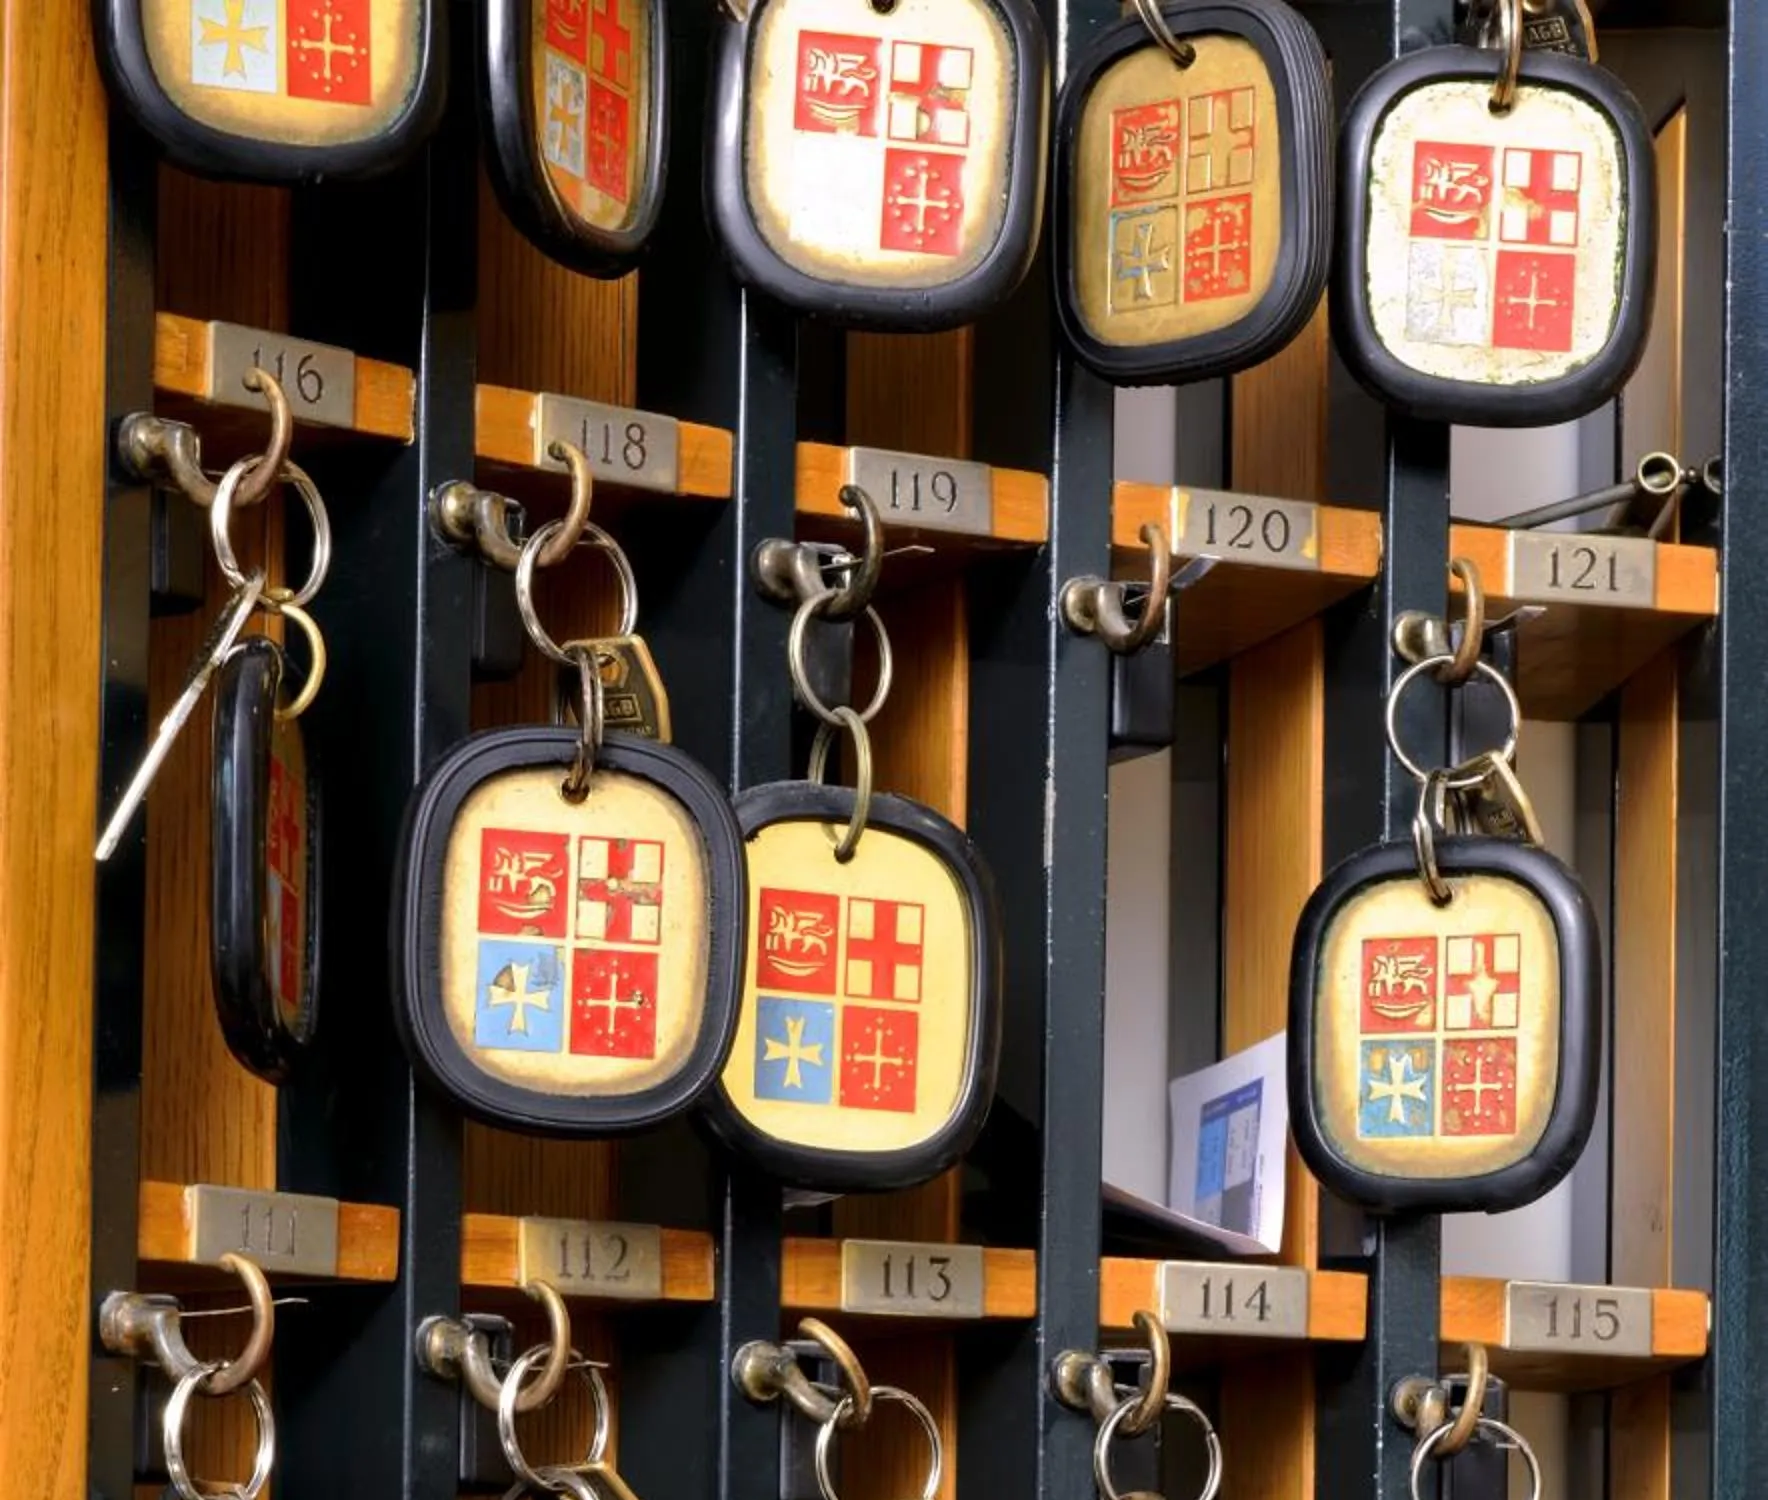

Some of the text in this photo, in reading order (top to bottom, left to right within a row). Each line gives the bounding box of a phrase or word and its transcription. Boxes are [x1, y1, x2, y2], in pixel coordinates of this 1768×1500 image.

[580, 418, 647, 470] 118
[889, 470, 957, 512] 119
[1204, 503, 1290, 553] 120
[1549, 548, 1620, 592] 121
[239, 1205, 297, 1256] 111
[557, 1235, 631, 1281] 112
[880, 1257, 952, 1302] 113
[1199, 1278, 1271, 1321] 114
[1544, 1299, 1619, 1340] 115
